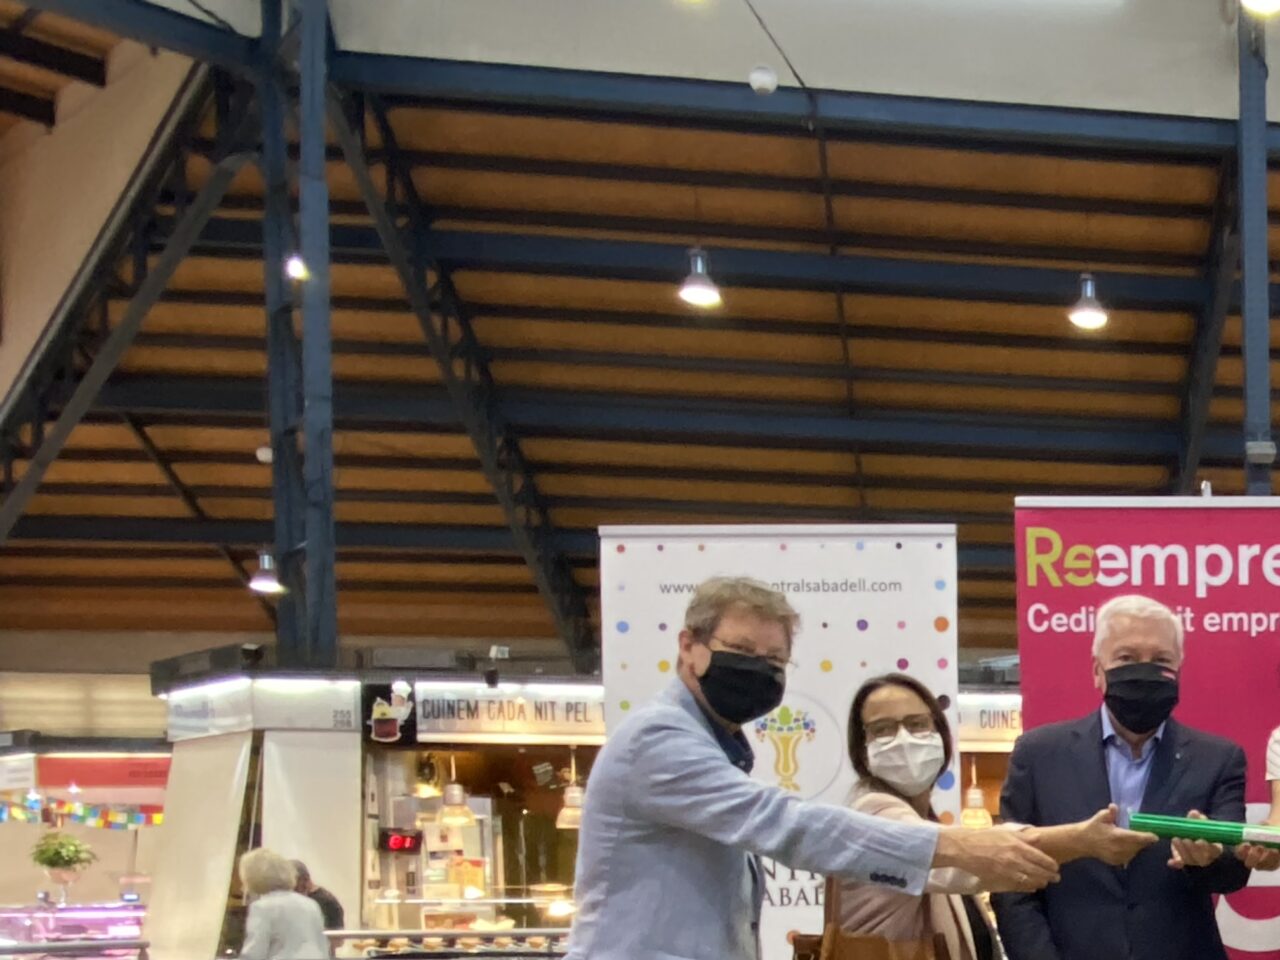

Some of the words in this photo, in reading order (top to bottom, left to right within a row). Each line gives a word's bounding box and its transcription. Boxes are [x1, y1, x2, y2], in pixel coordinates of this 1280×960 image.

[659, 578, 902, 594] wwwntralsabadell.com
[1027, 603, 1096, 633] Cedi
[422, 698, 479, 720] CUINEM
[488, 700, 527, 720] CADA
[534, 701, 556, 721] NIT
[565, 702, 592, 722] PEL
[980, 708, 1022, 729] CUINE
